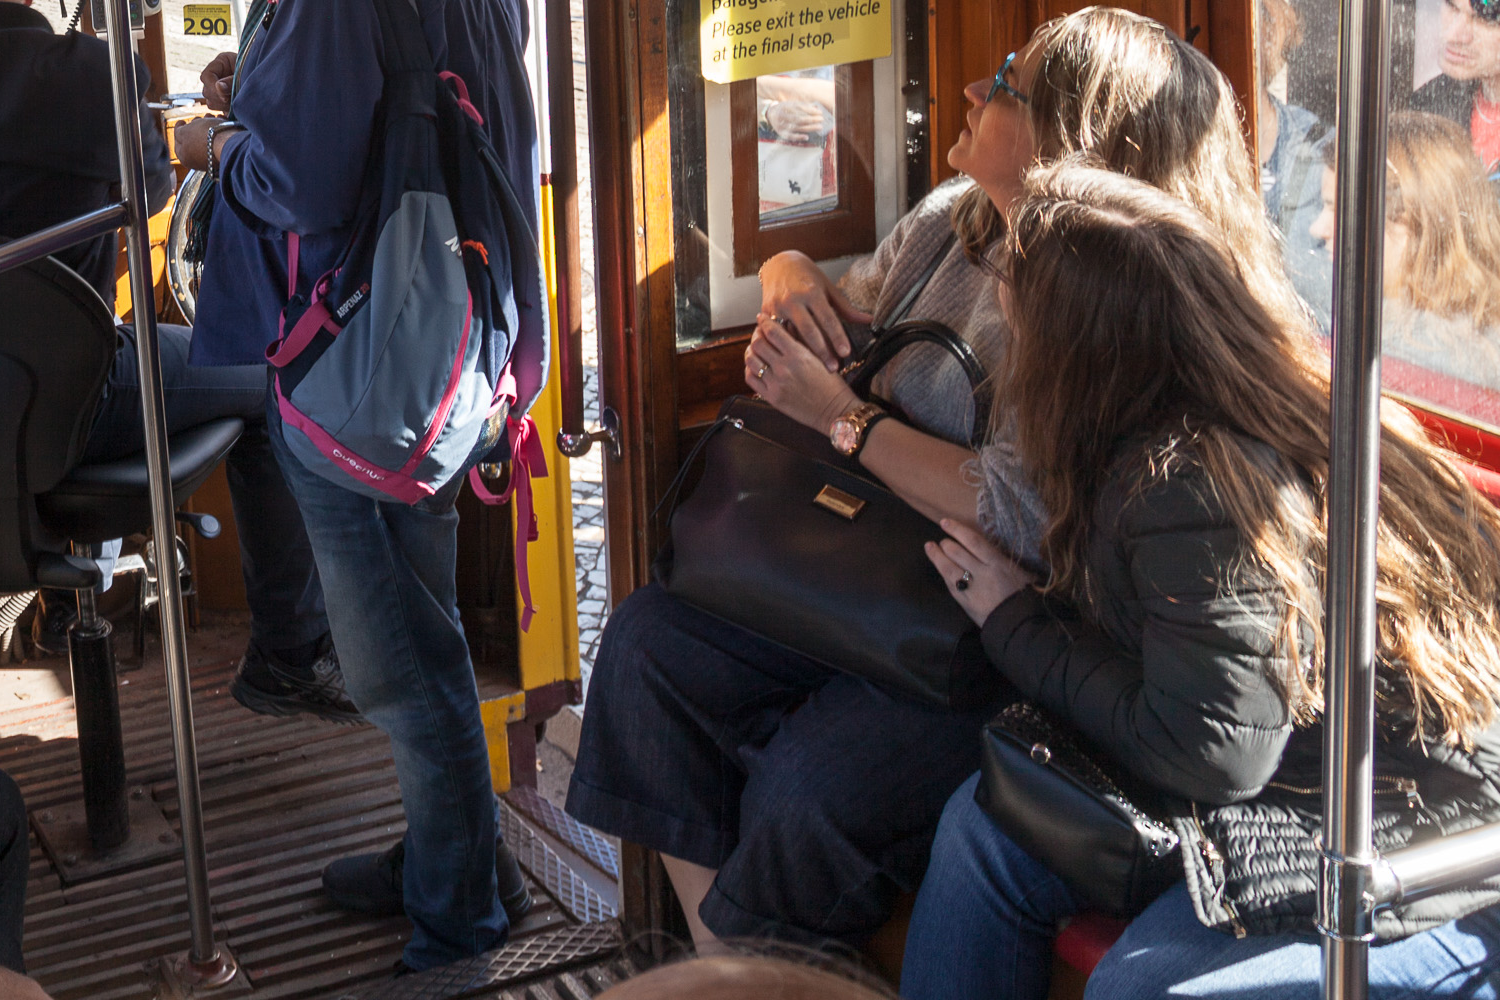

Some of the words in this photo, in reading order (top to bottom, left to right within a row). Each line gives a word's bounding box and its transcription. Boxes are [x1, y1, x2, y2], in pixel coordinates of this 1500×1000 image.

[184, 18, 228, 35] 2.90
[712, 18, 762, 39] Please
[766, 11, 796, 30] exit
[799, 7, 824, 25] the
[713, 48, 727, 63] at
[733, 42, 757, 60] the
[762, 33, 794, 55] final
[798, 32, 835, 50] stop.
[336, 290, 363, 319] ARPENAZ
